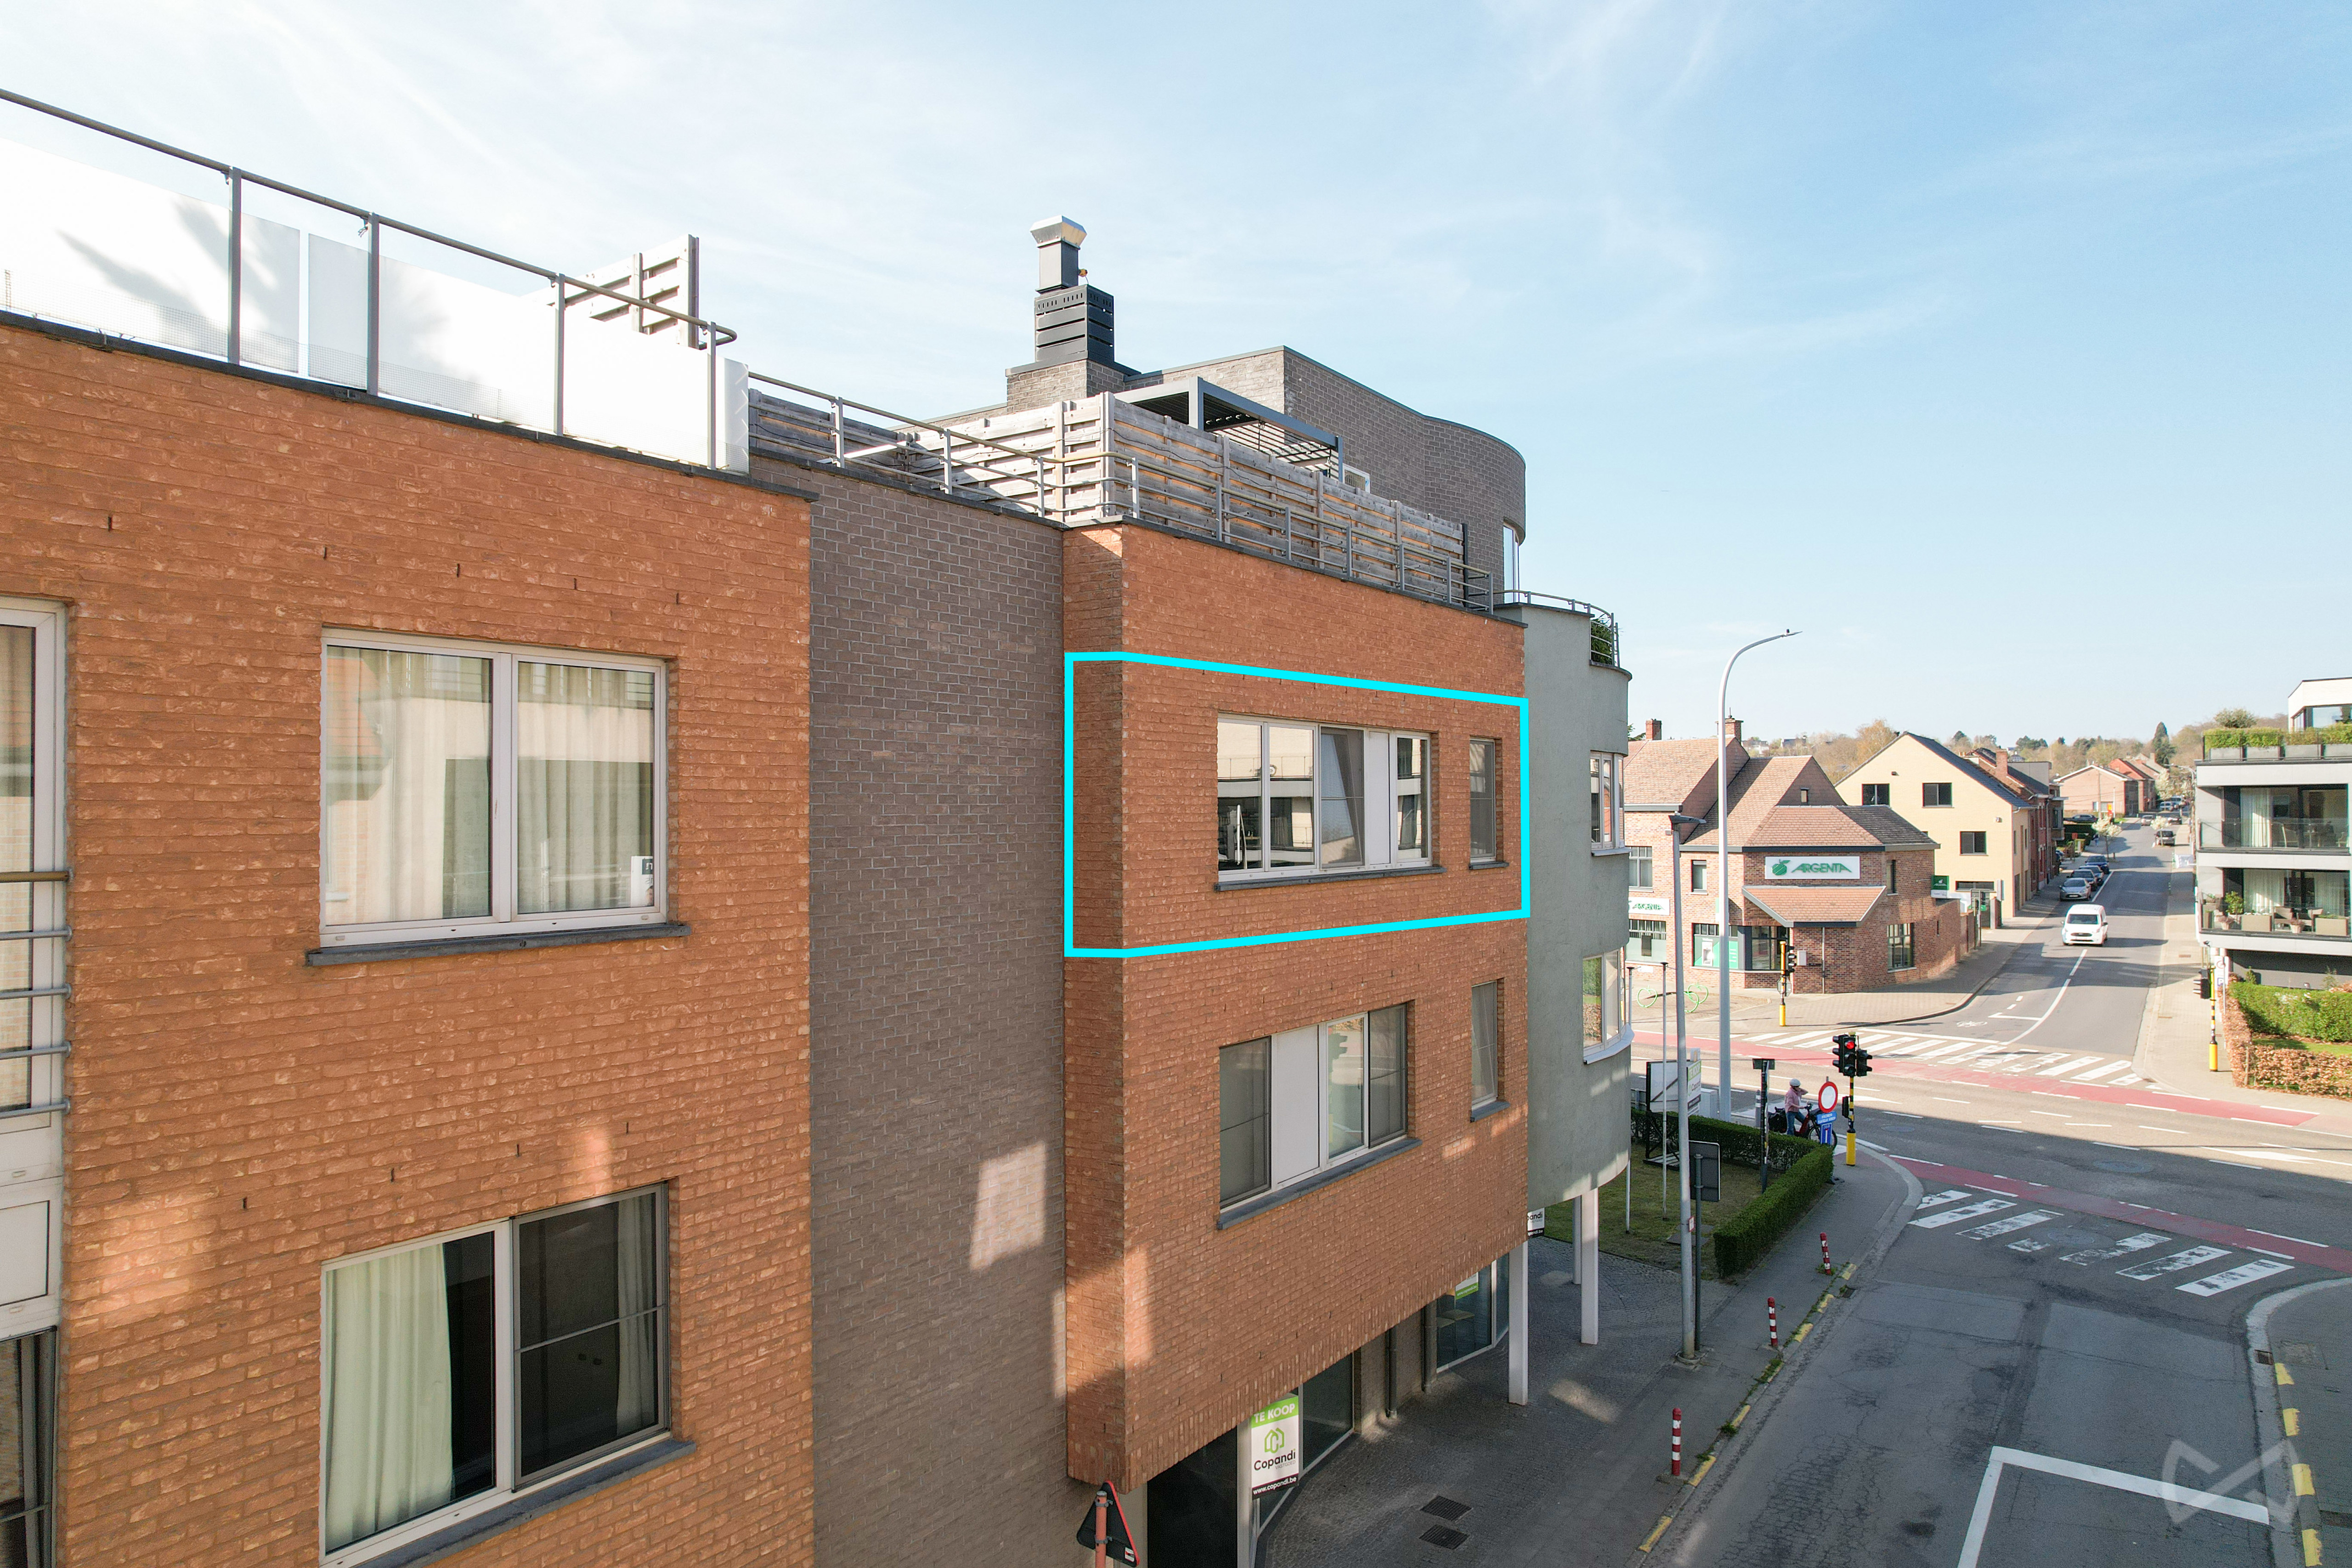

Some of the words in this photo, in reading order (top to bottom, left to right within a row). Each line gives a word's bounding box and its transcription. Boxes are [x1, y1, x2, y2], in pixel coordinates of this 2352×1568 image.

[1791, 863, 1852, 873] ARGENTA
[1254, 1412, 1265, 1423] TE
[1268, 1403, 1295, 1420] KOOP
[1254, 1449, 1295, 1471] Copandi
[1275, 1460, 1296, 1470] VASTGOED
[1253, 1476, 1297, 1494] www.copandi.be
